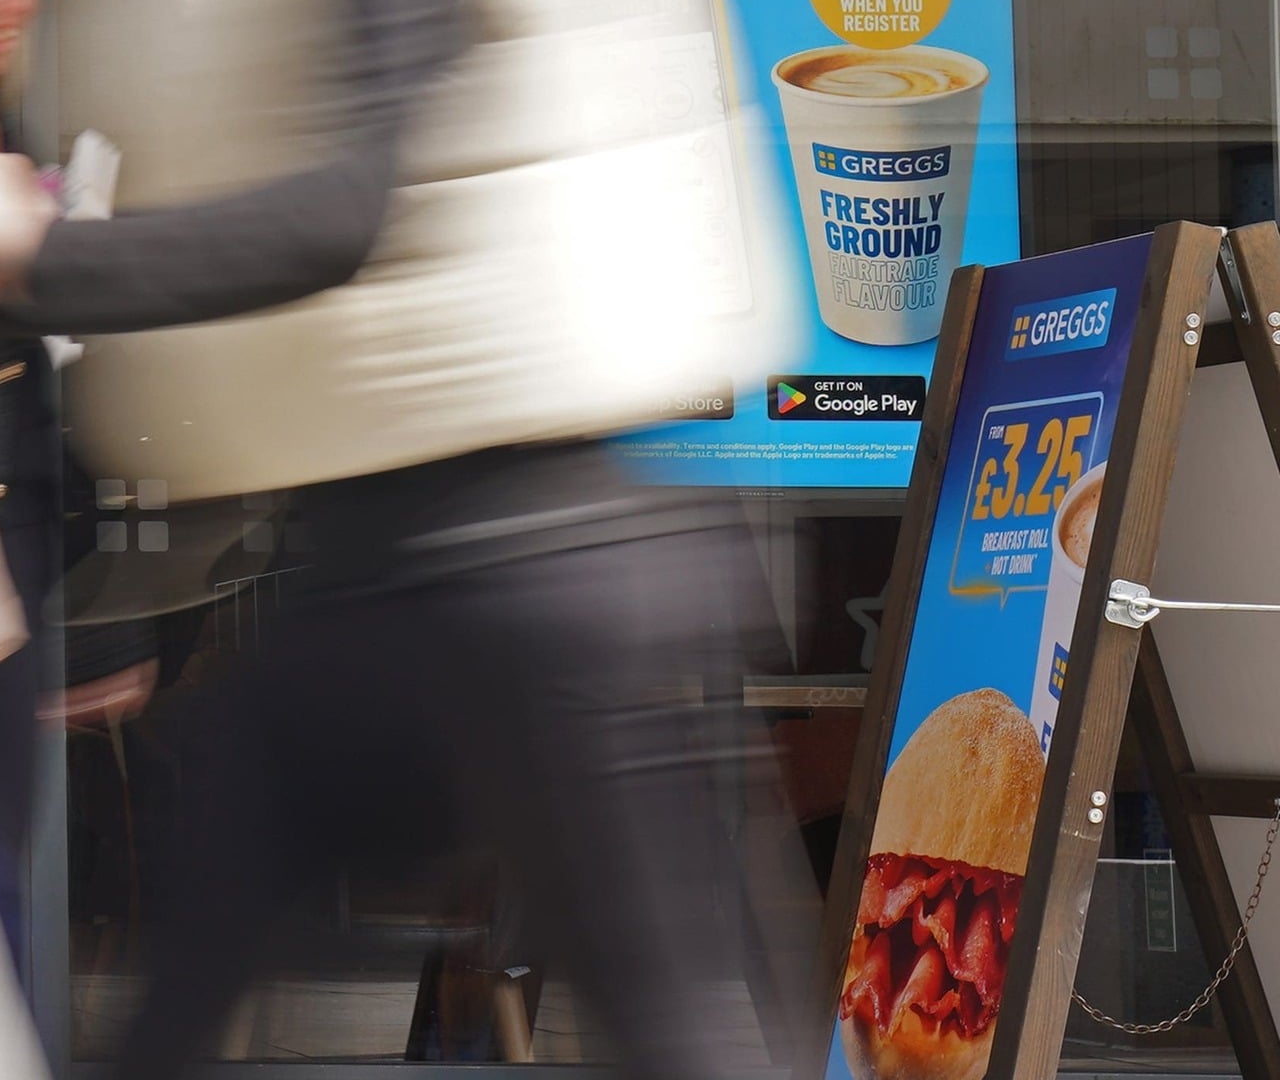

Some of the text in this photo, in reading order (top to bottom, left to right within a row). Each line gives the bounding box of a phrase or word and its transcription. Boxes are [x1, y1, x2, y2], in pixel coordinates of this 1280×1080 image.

[843, 15, 920, 32] REGISTER
[841, 153, 945, 175] GREGGS
[820, 189, 945, 226] FRESHLY
[825, 221, 941, 258] GROUND
[828, 251, 939, 283] FAIRTRADE
[831, 277, 936, 312] FLAVOUR
[1031, 301, 1109, 345] GREGGS
[814, 381, 863, 391] GET IT ON
[674, 396, 724, 411] Store
[814, 394, 917, 415] Google Play
[988, 425, 1005, 440] FROM
[972, 415, 1092, 520] £3.25
[981, 528, 1049, 552] BREAKFAST ROLL
[991, 555, 1009, 575] HOT
